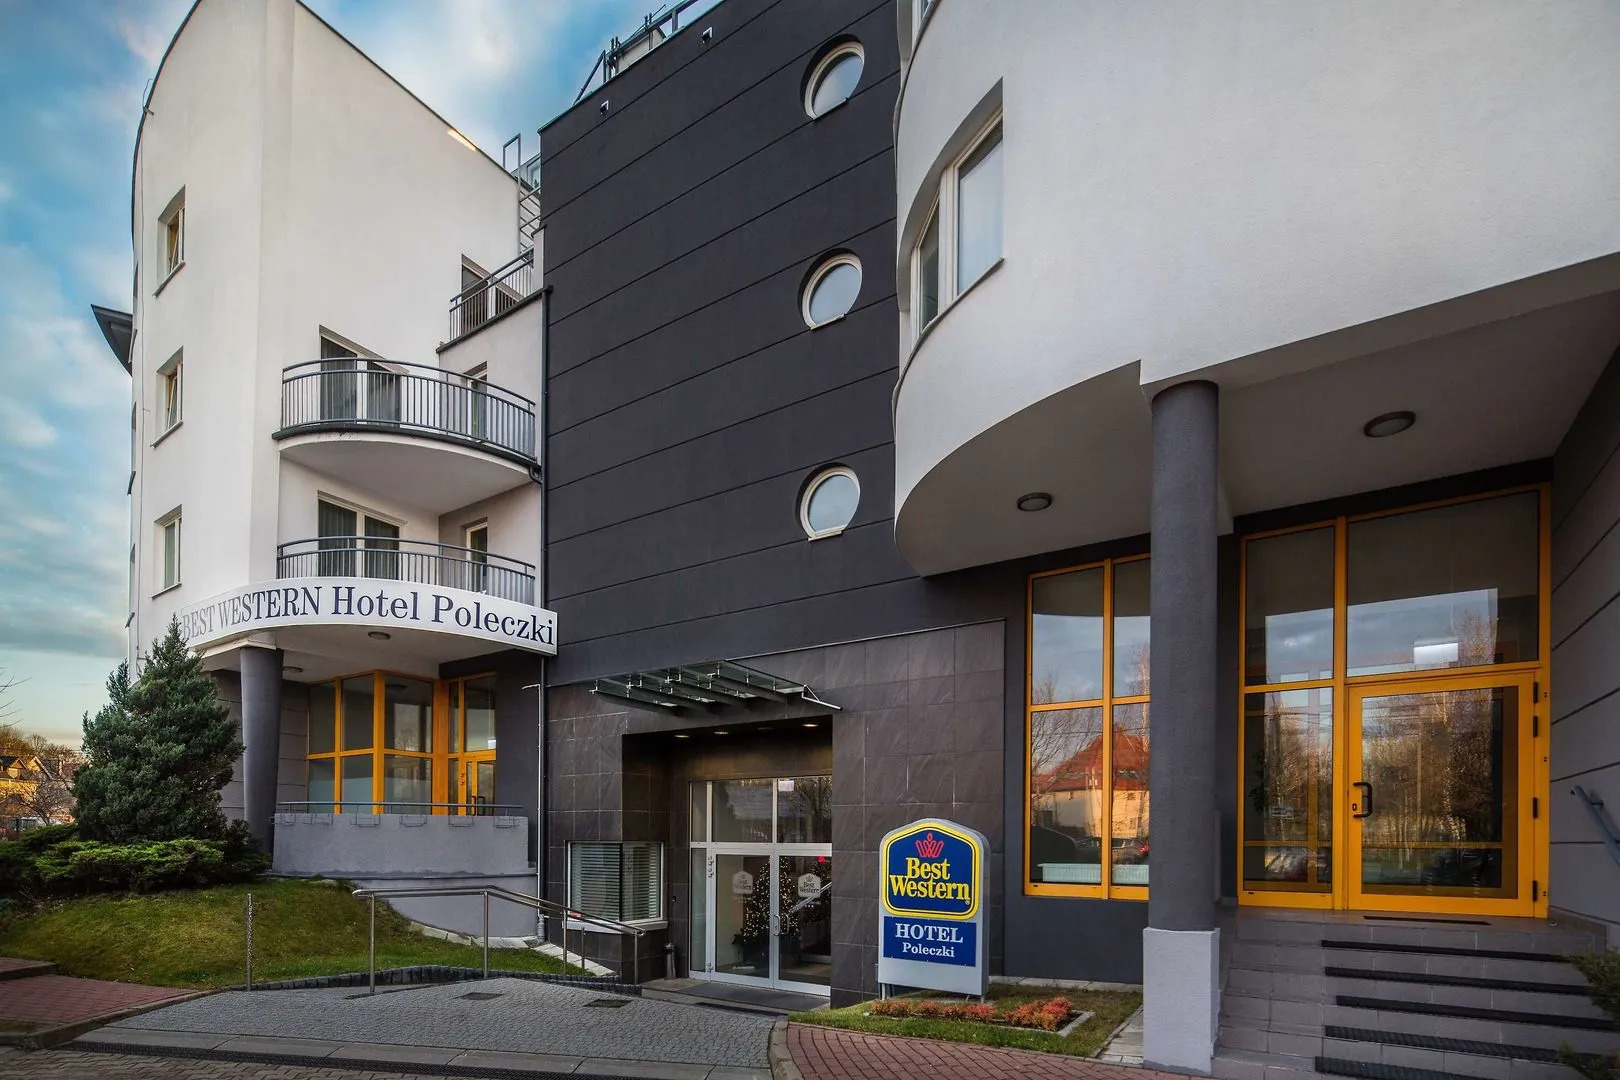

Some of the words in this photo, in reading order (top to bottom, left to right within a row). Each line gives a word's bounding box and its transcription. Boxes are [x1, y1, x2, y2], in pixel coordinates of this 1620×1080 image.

[182, 605, 216, 640] BEST
[218, 586, 322, 629] WESTERN
[331, 586, 420, 620] Hotel
[431, 594, 555, 645] Poleczki
[906, 857, 950, 880] Best
[889, 874, 970, 900] Western
[895, 923, 963, 943] HOTEL
[902, 942, 955, 957] Poleczki
